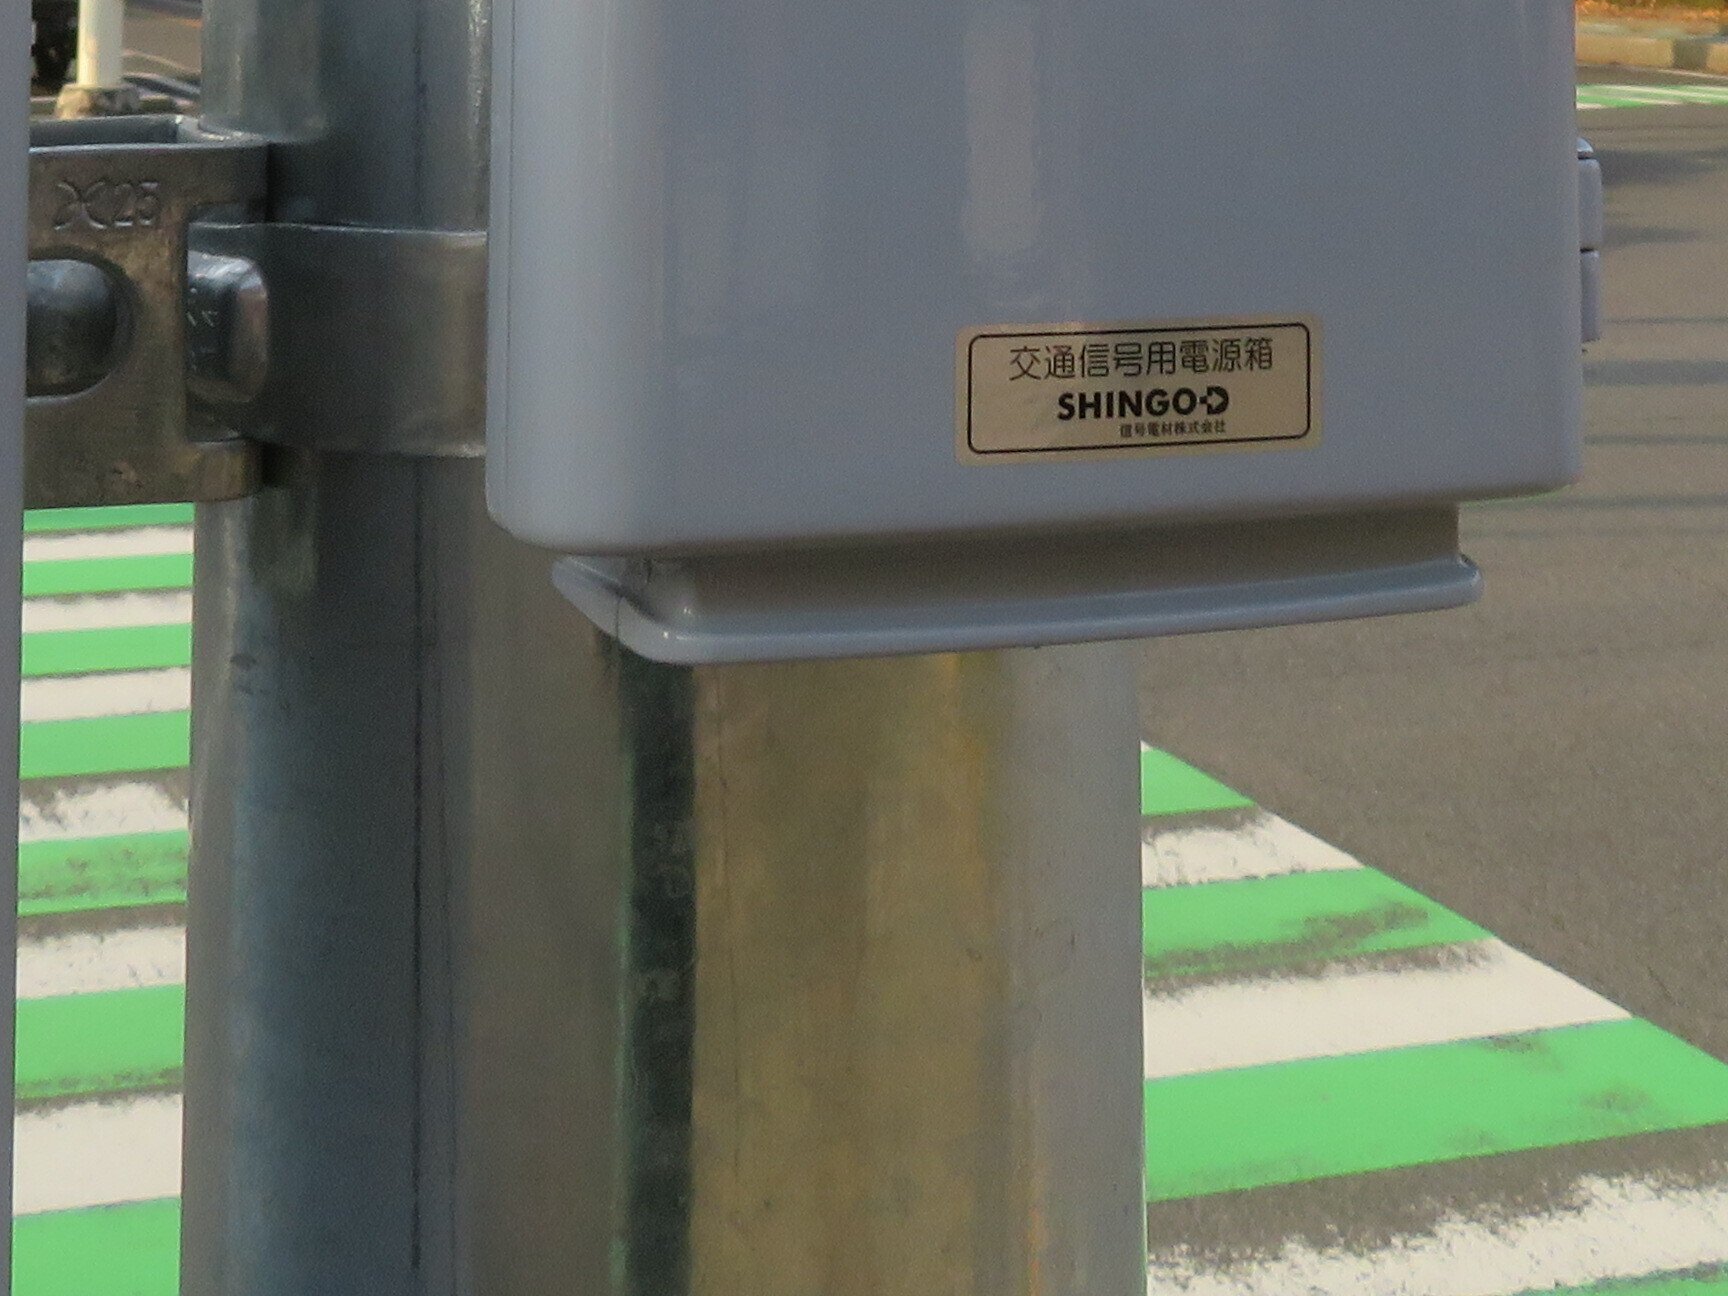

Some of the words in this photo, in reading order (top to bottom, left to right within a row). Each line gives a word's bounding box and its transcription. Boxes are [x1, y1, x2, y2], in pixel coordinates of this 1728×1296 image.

[1009, 337, 1274, 383] 交通信号用電源箱
